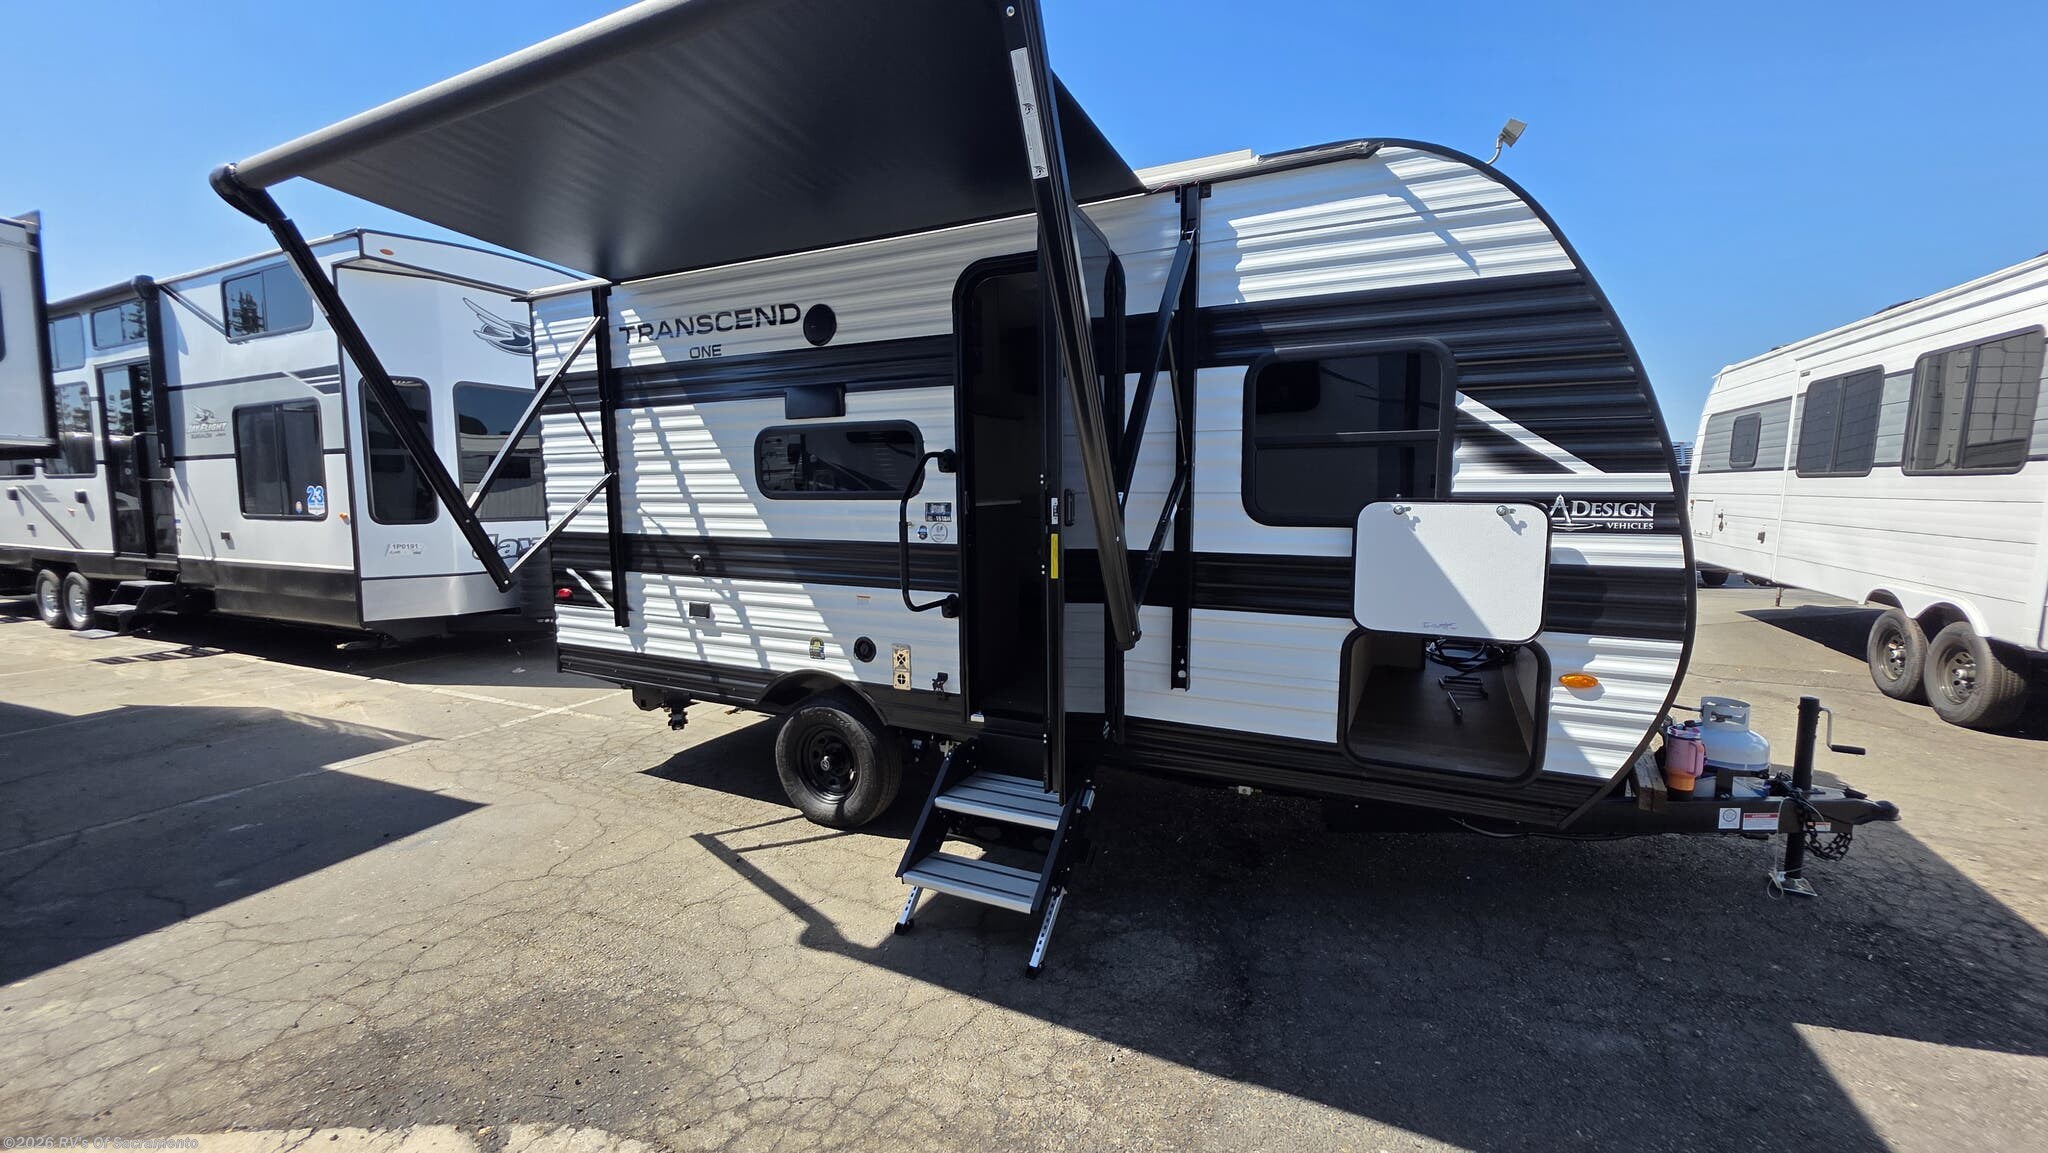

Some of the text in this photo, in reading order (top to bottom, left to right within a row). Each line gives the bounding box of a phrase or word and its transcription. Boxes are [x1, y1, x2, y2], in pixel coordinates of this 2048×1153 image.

[618, 303, 801, 345] TRANSCEND
[689, 344, 722, 359] ONE
[306, 485, 325, 504] 23
[1606, 522, 1655, 530] VEHICLES
